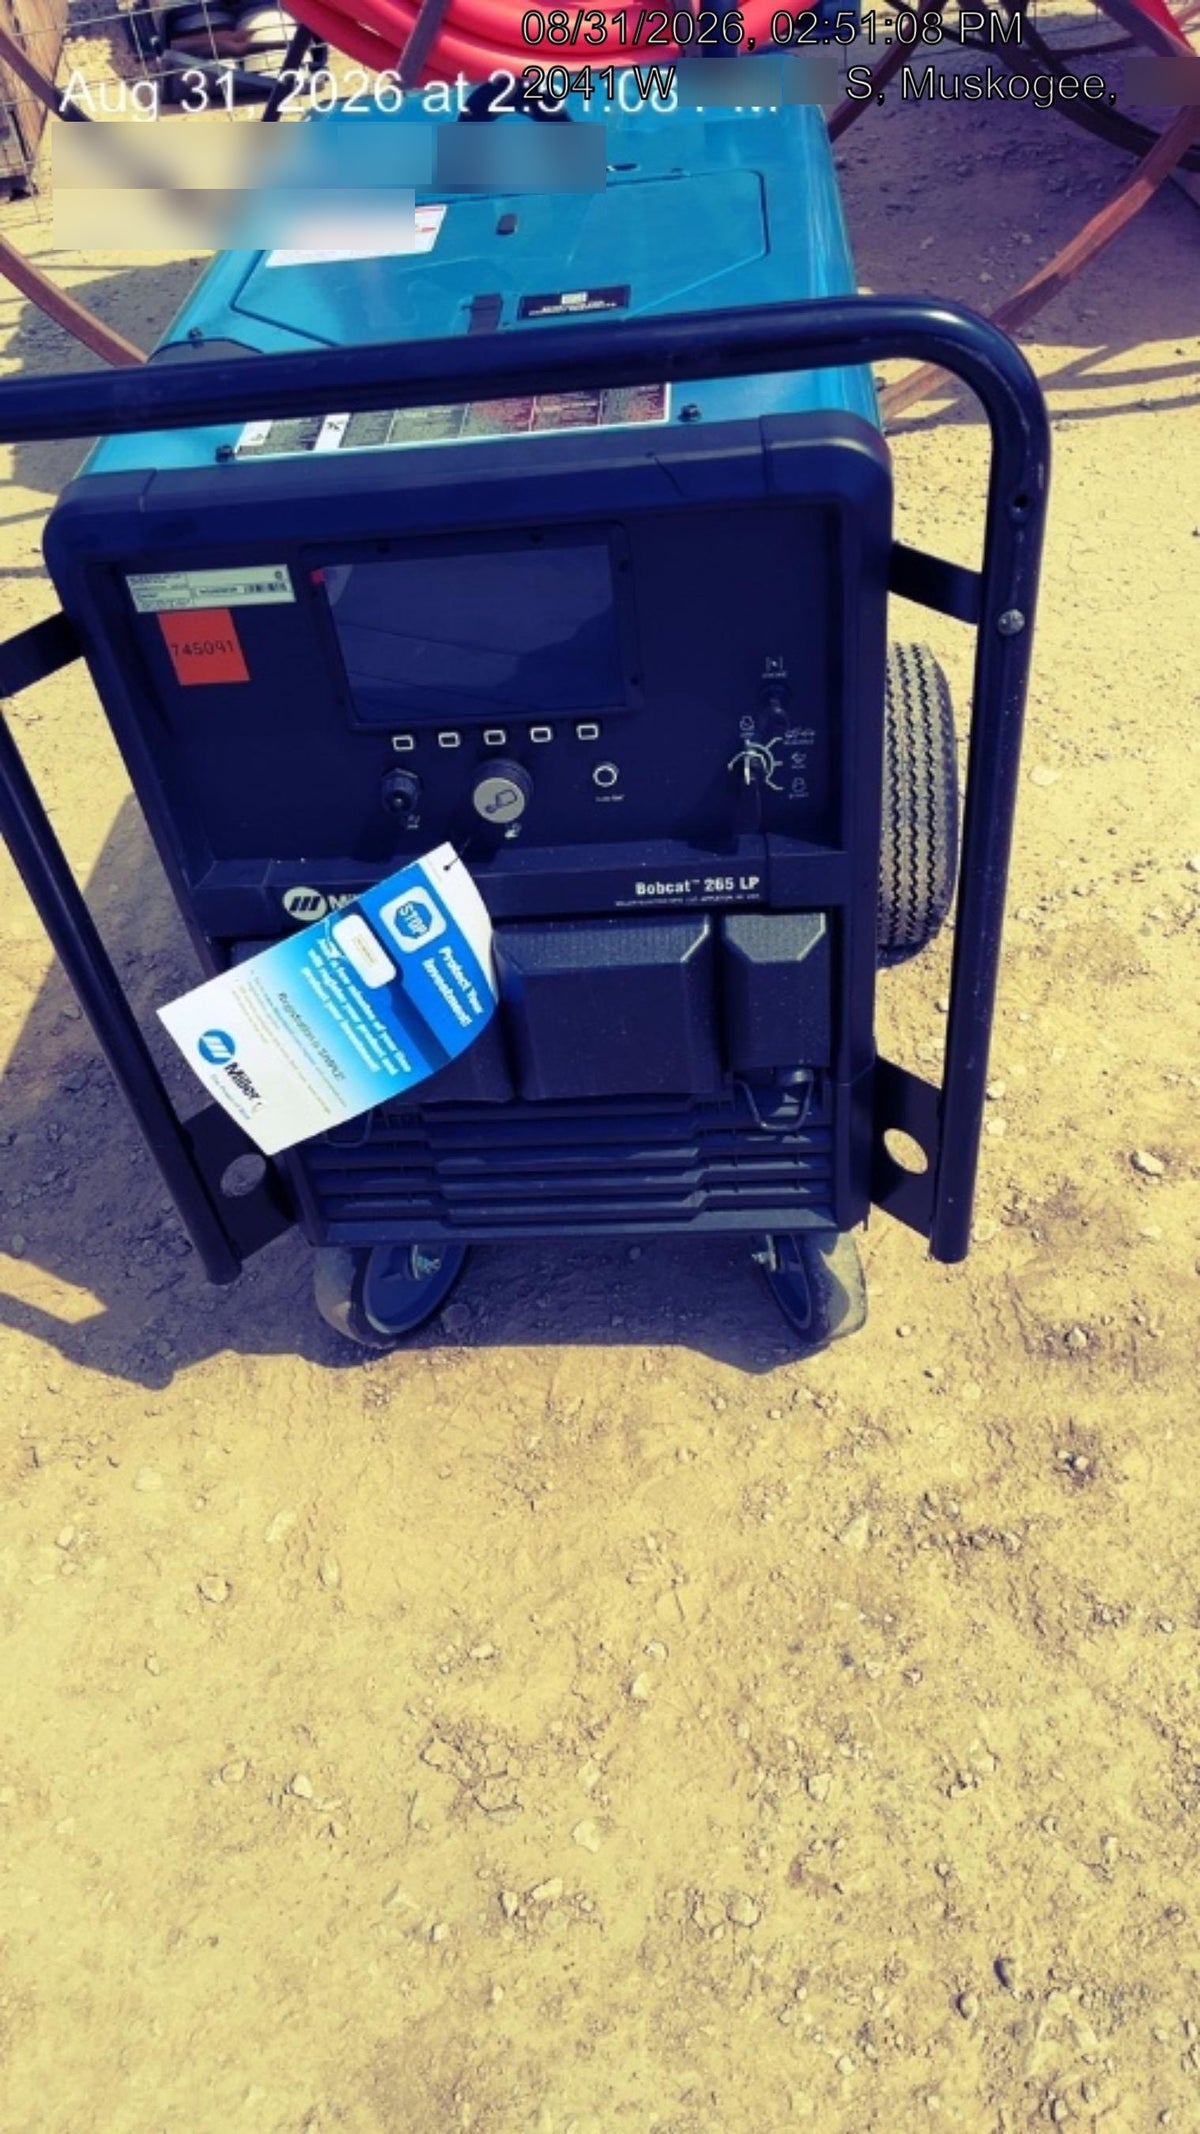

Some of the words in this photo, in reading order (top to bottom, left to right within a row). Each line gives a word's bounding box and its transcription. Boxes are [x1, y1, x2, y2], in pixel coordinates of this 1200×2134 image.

[703, 876, 735, 893] 265
[739, 876, 760, 891] LP
[397, 901, 428, 938] STOP
[437, 945, 473, 991] Protect
[224, 1060, 260, 1105] Miller
